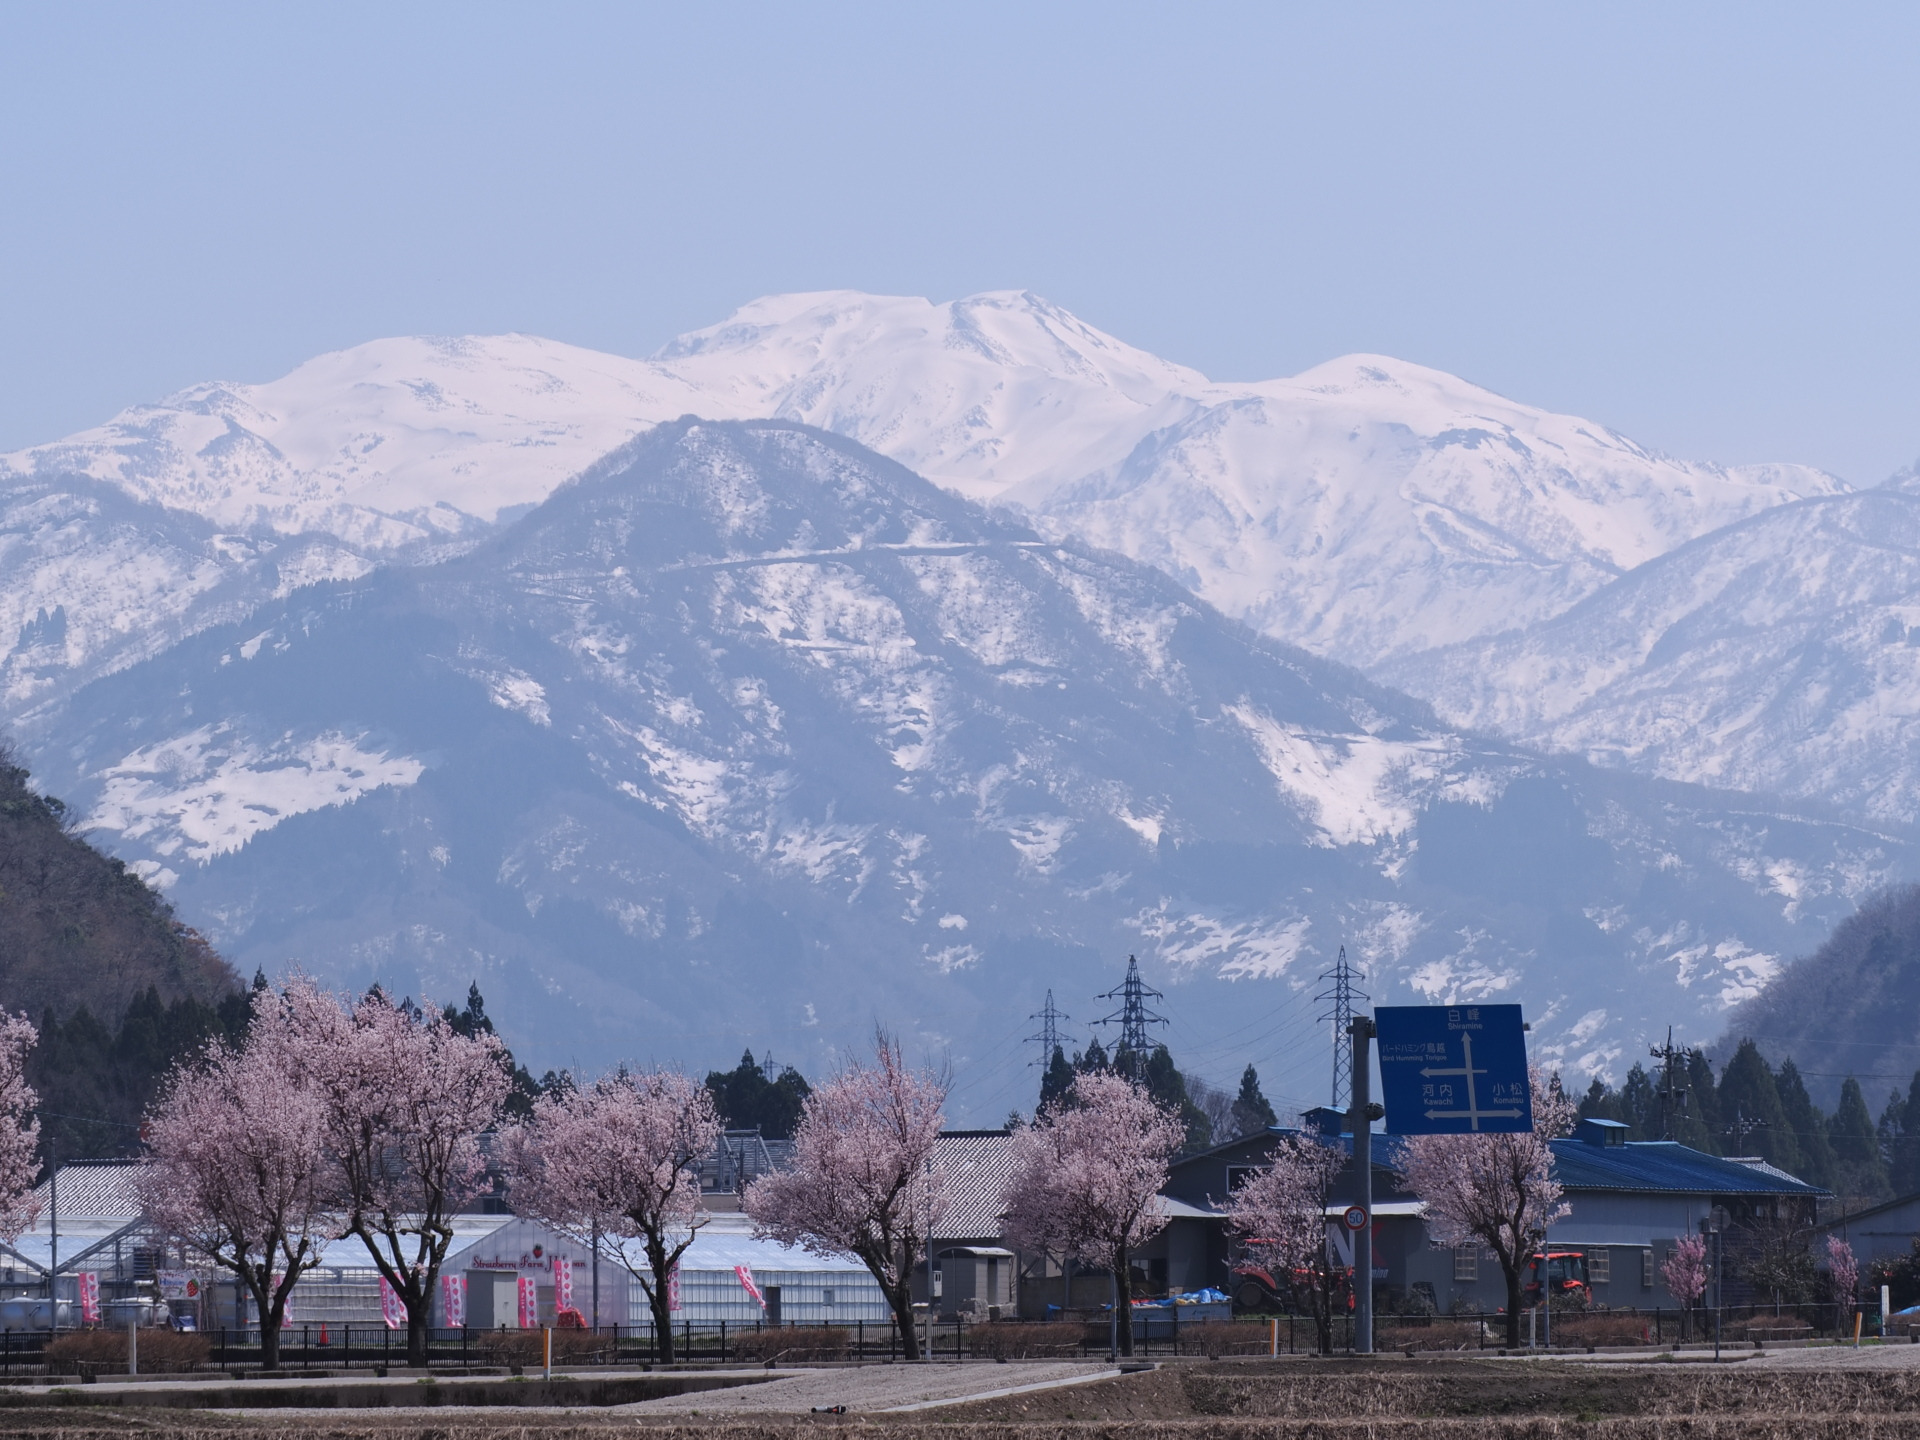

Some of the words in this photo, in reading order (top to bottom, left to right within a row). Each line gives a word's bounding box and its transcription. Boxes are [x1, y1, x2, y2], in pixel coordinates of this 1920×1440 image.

[1448, 1009, 1480, 1021] 白峰
[1448, 1022, 1483, 1030] Shiramine
[1425, 1054, 1447, 1062] Torigoe
[1422, 1084, 1453, 1097] 河内
[1492, 1082, 1523, 1096] 小松
[1493, 1097, 1524, 1105] Komatsu
[1349, 1212, 1363, 1224] 50
[473, 1256, 516, 1269] Strawberry
